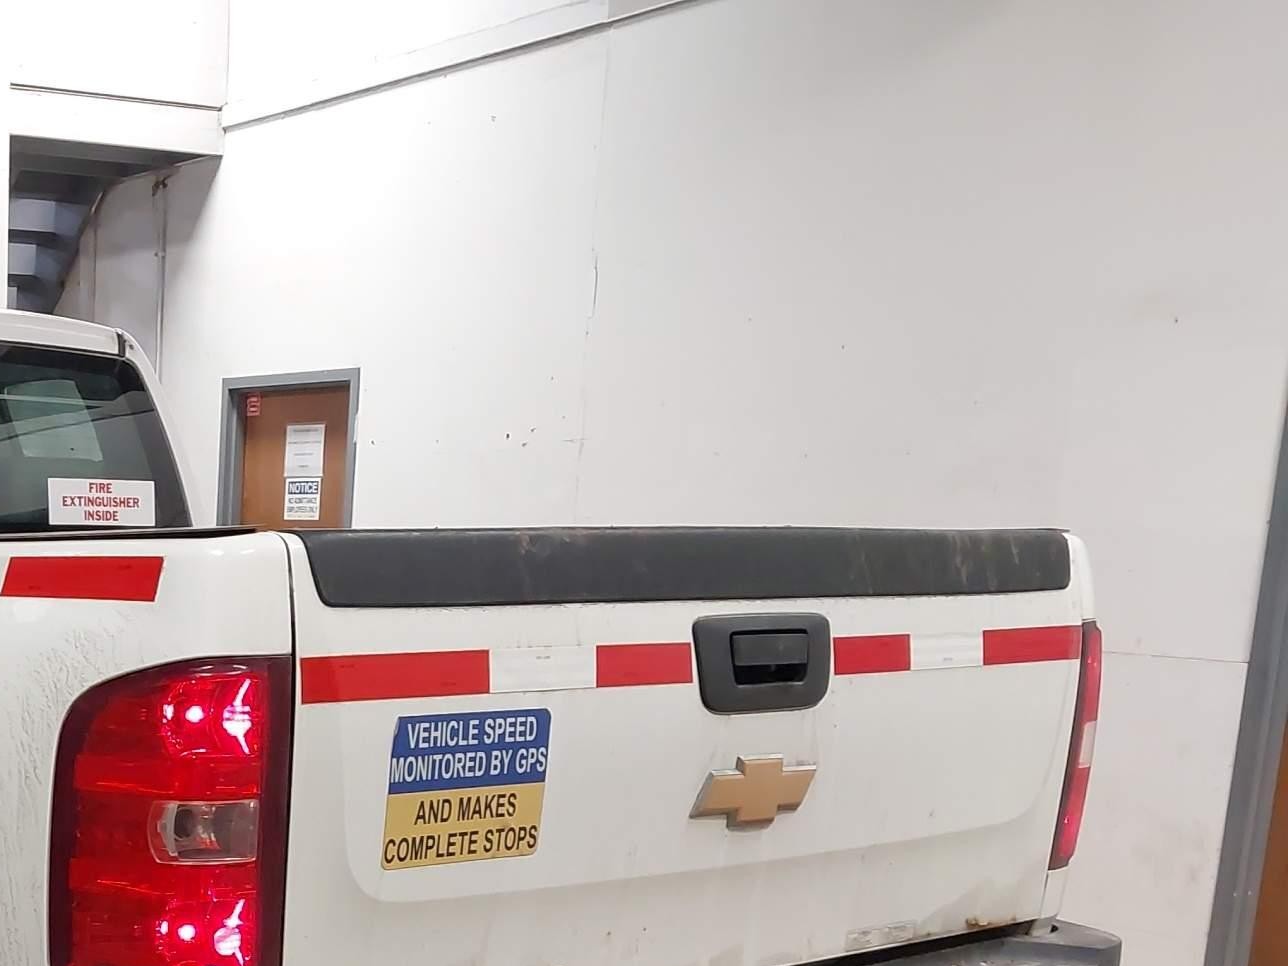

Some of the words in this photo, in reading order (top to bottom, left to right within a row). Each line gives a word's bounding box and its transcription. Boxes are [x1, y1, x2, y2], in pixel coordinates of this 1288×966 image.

[89, 483, 112, 493] FIRE
[289, 482, 318, 493] NOTICE
[62, 496, 140, 508] EXTINGUISHER
[84, 510, 119, 521] INSIDE
[407, 719, 480, 749] VEHICLE
[483, 715, 538, 745] SPEED
[390, 752, 486, 784] MONITORED
[489, 751, 511, 776] BY
[515, 747, 547, 774] GPS
[414, 799, 452, 825] AND
[456, 793, 517, 822] MAKES
[384, 832, 478, 863] COMPLETE
[482, 825, 538, 855] STOPS
